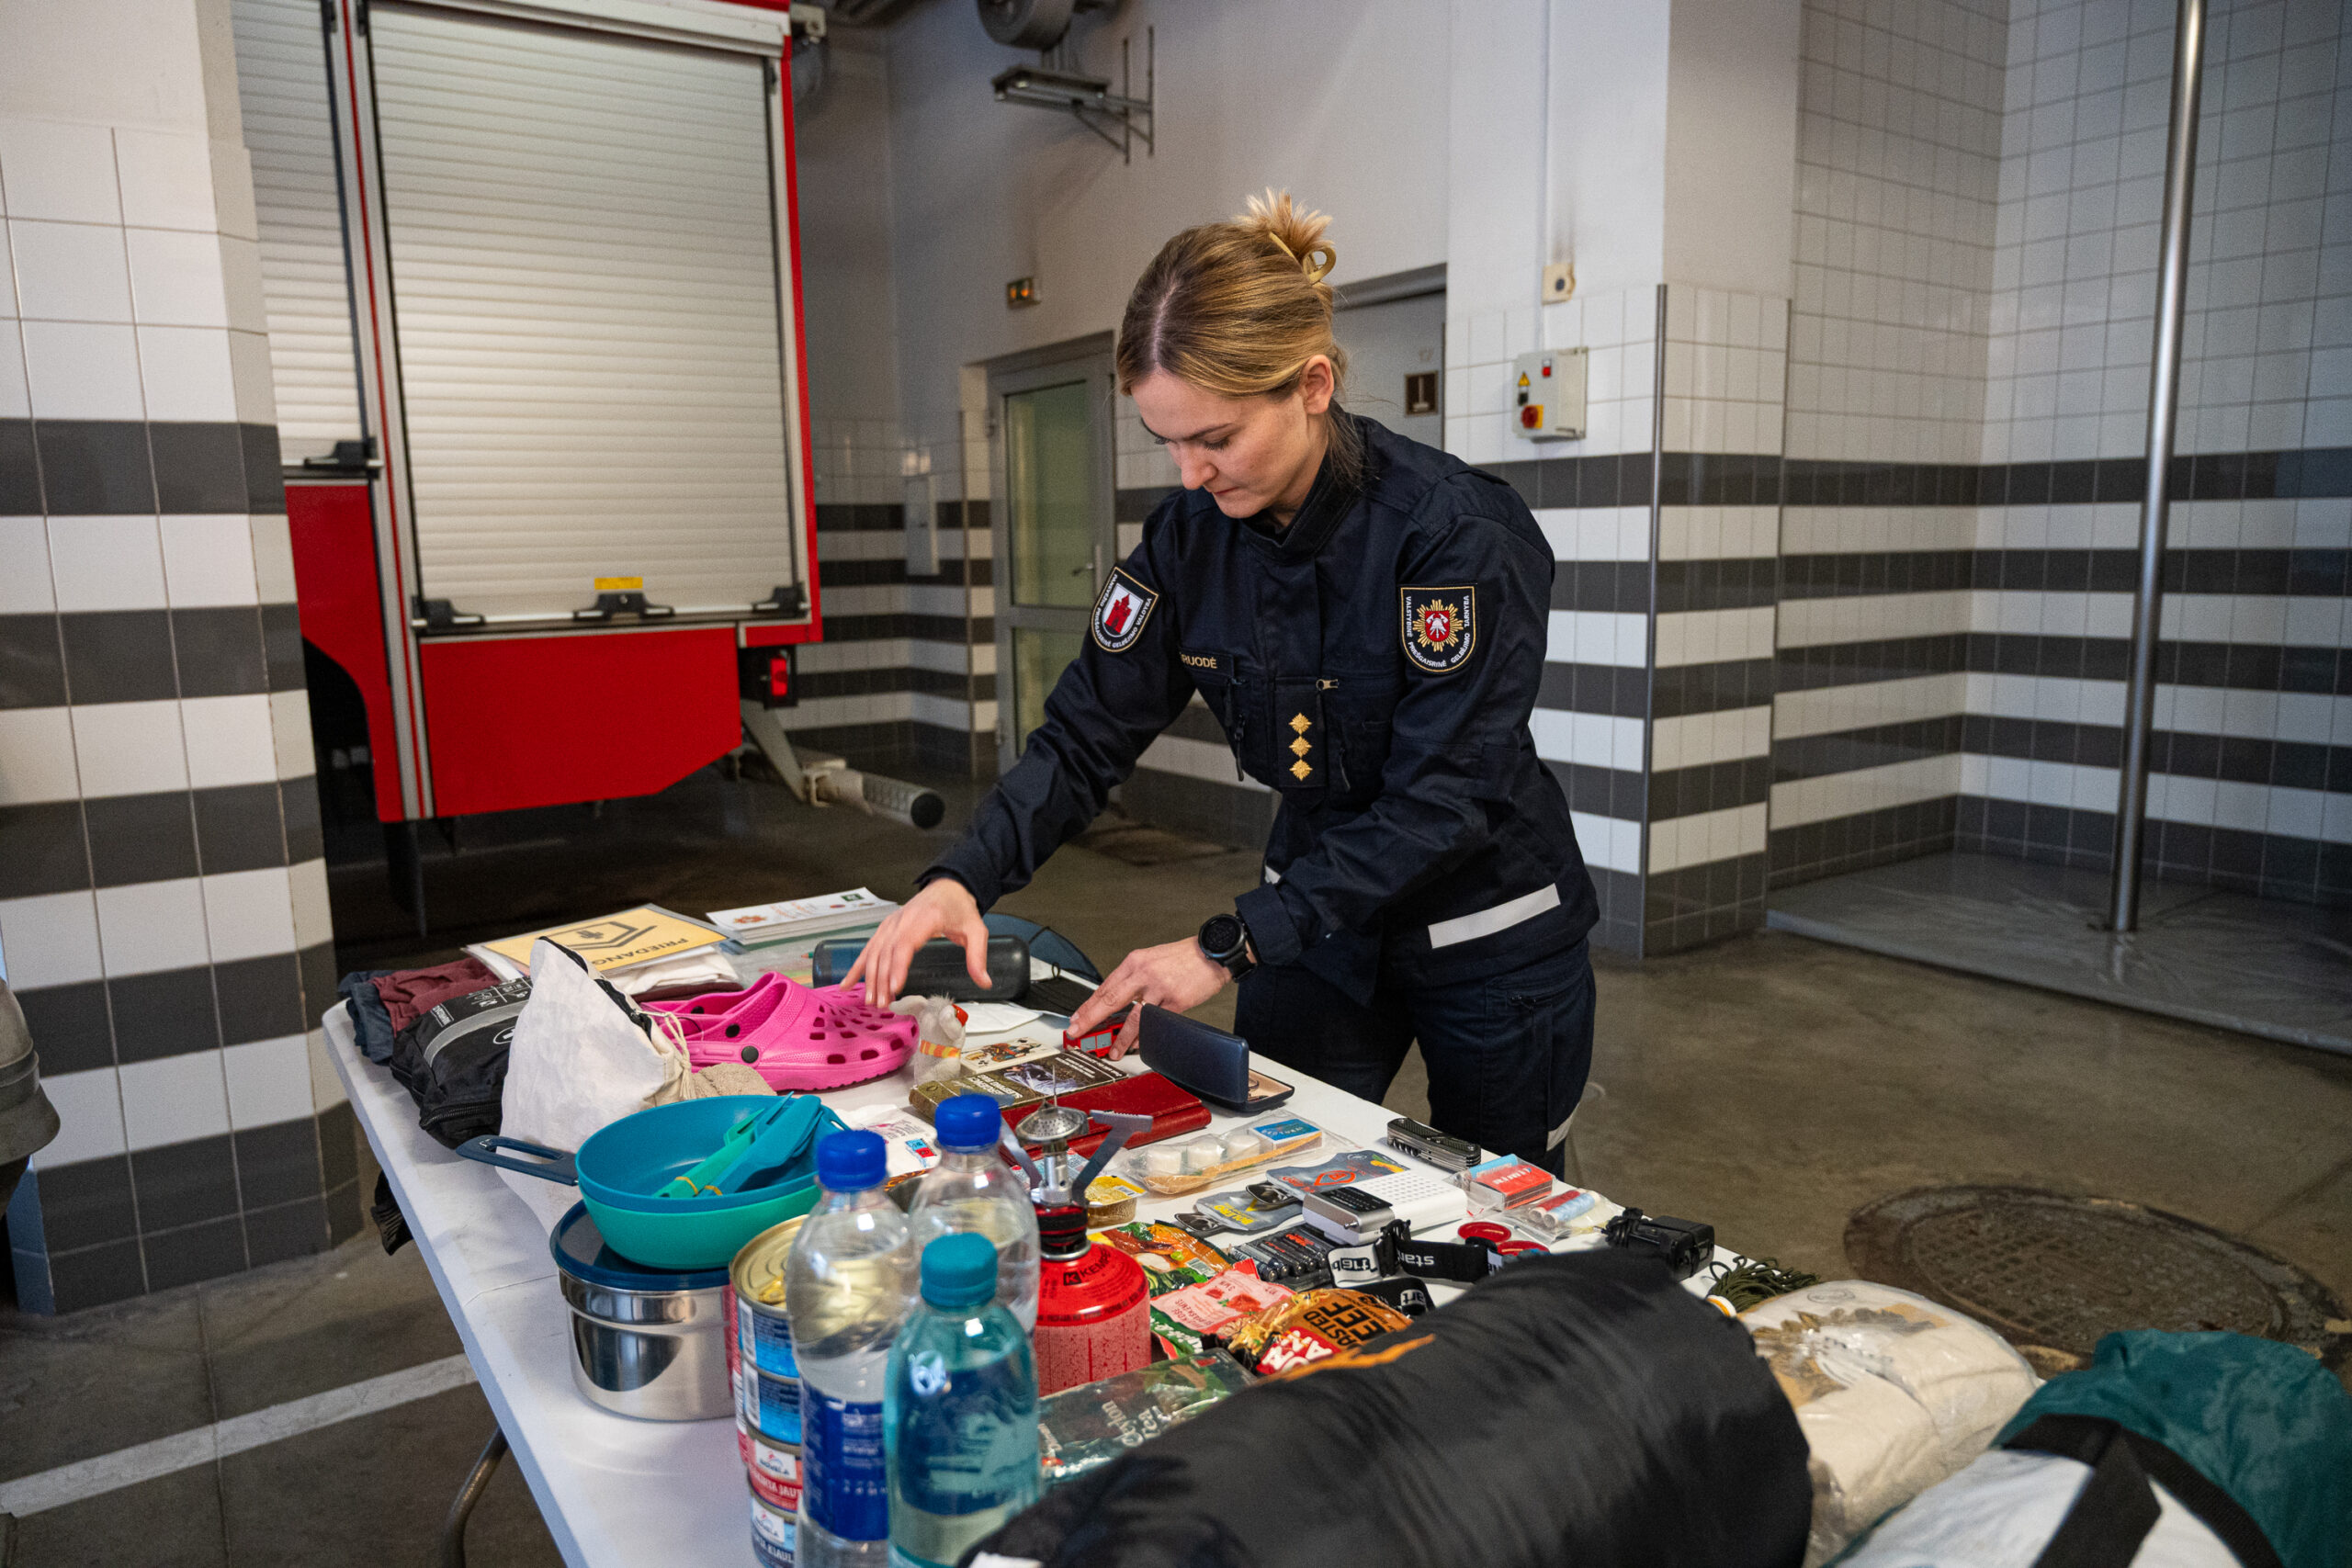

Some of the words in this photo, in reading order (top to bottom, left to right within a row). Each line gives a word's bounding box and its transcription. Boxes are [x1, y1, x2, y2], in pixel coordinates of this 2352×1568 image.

[1136, 597, 1153, 626] VALDYBA
[1406, 595, 1414, 637] VALSTYBINĖ
[1181, 653, 1218, 669] RUODĖ
[1408, 641, 1448, 668] PRIEŠGAISRINĖ
[1450, 632, 1471, 663] GELBĖJIMO
[590, 936, 689, 964] PRIEDANG
[1396, 1249, 1435, 1268] star
[1403, 1292, 1424, 1304] art
[1303, 1311, 1359, 1347] ASTED
[1319, 1303, 1386, 1341] EEF
